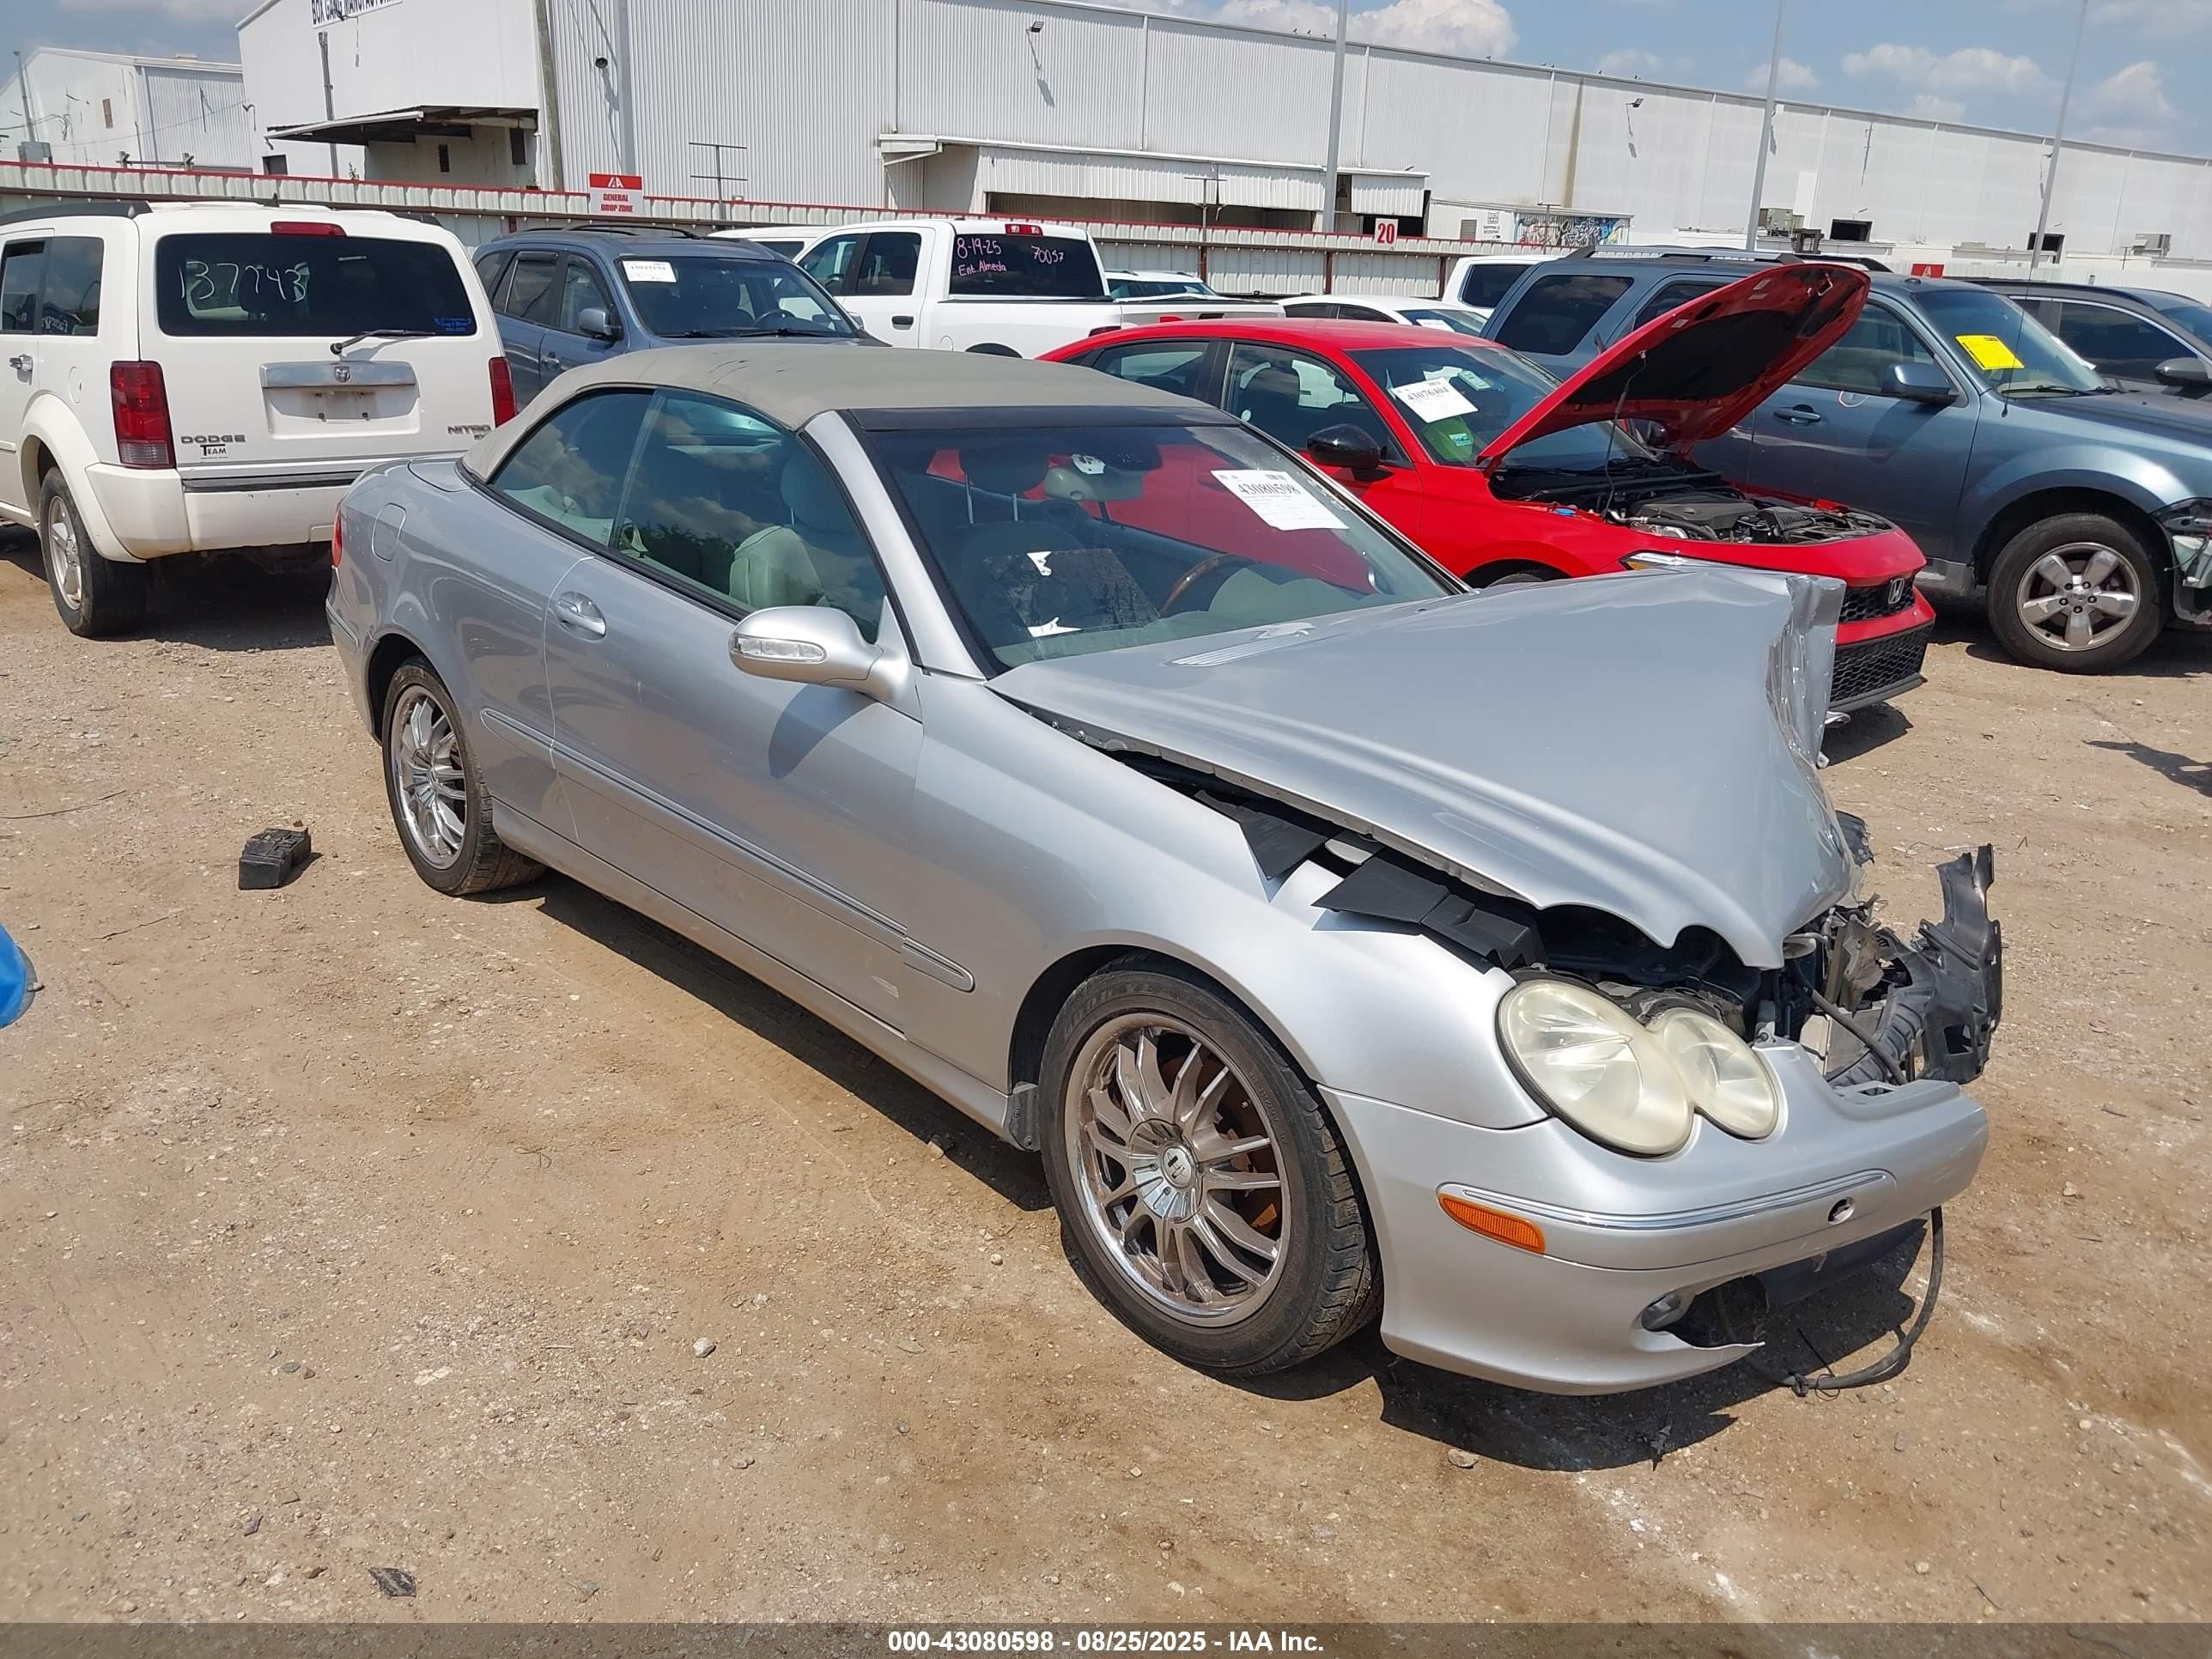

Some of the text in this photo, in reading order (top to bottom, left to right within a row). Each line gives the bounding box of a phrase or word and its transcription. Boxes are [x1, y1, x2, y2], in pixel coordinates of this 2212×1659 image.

[604, 193, 629, 202] GENERAL
[618, 205, 634, 214] ZONE
[1377, 222, 1395, 244] 20
[957, 237, 1002, 259] 8-19-25
[979, 260, 1006, 272] Almeda
[179, 260, 306, 303] 137743
[447, 424, 491, 434] NITRO
[180, 434, 246, 444] DODGE
[200, 443, 227, 457] TEAM
[1237, 483, 1302, 495] 43080598
